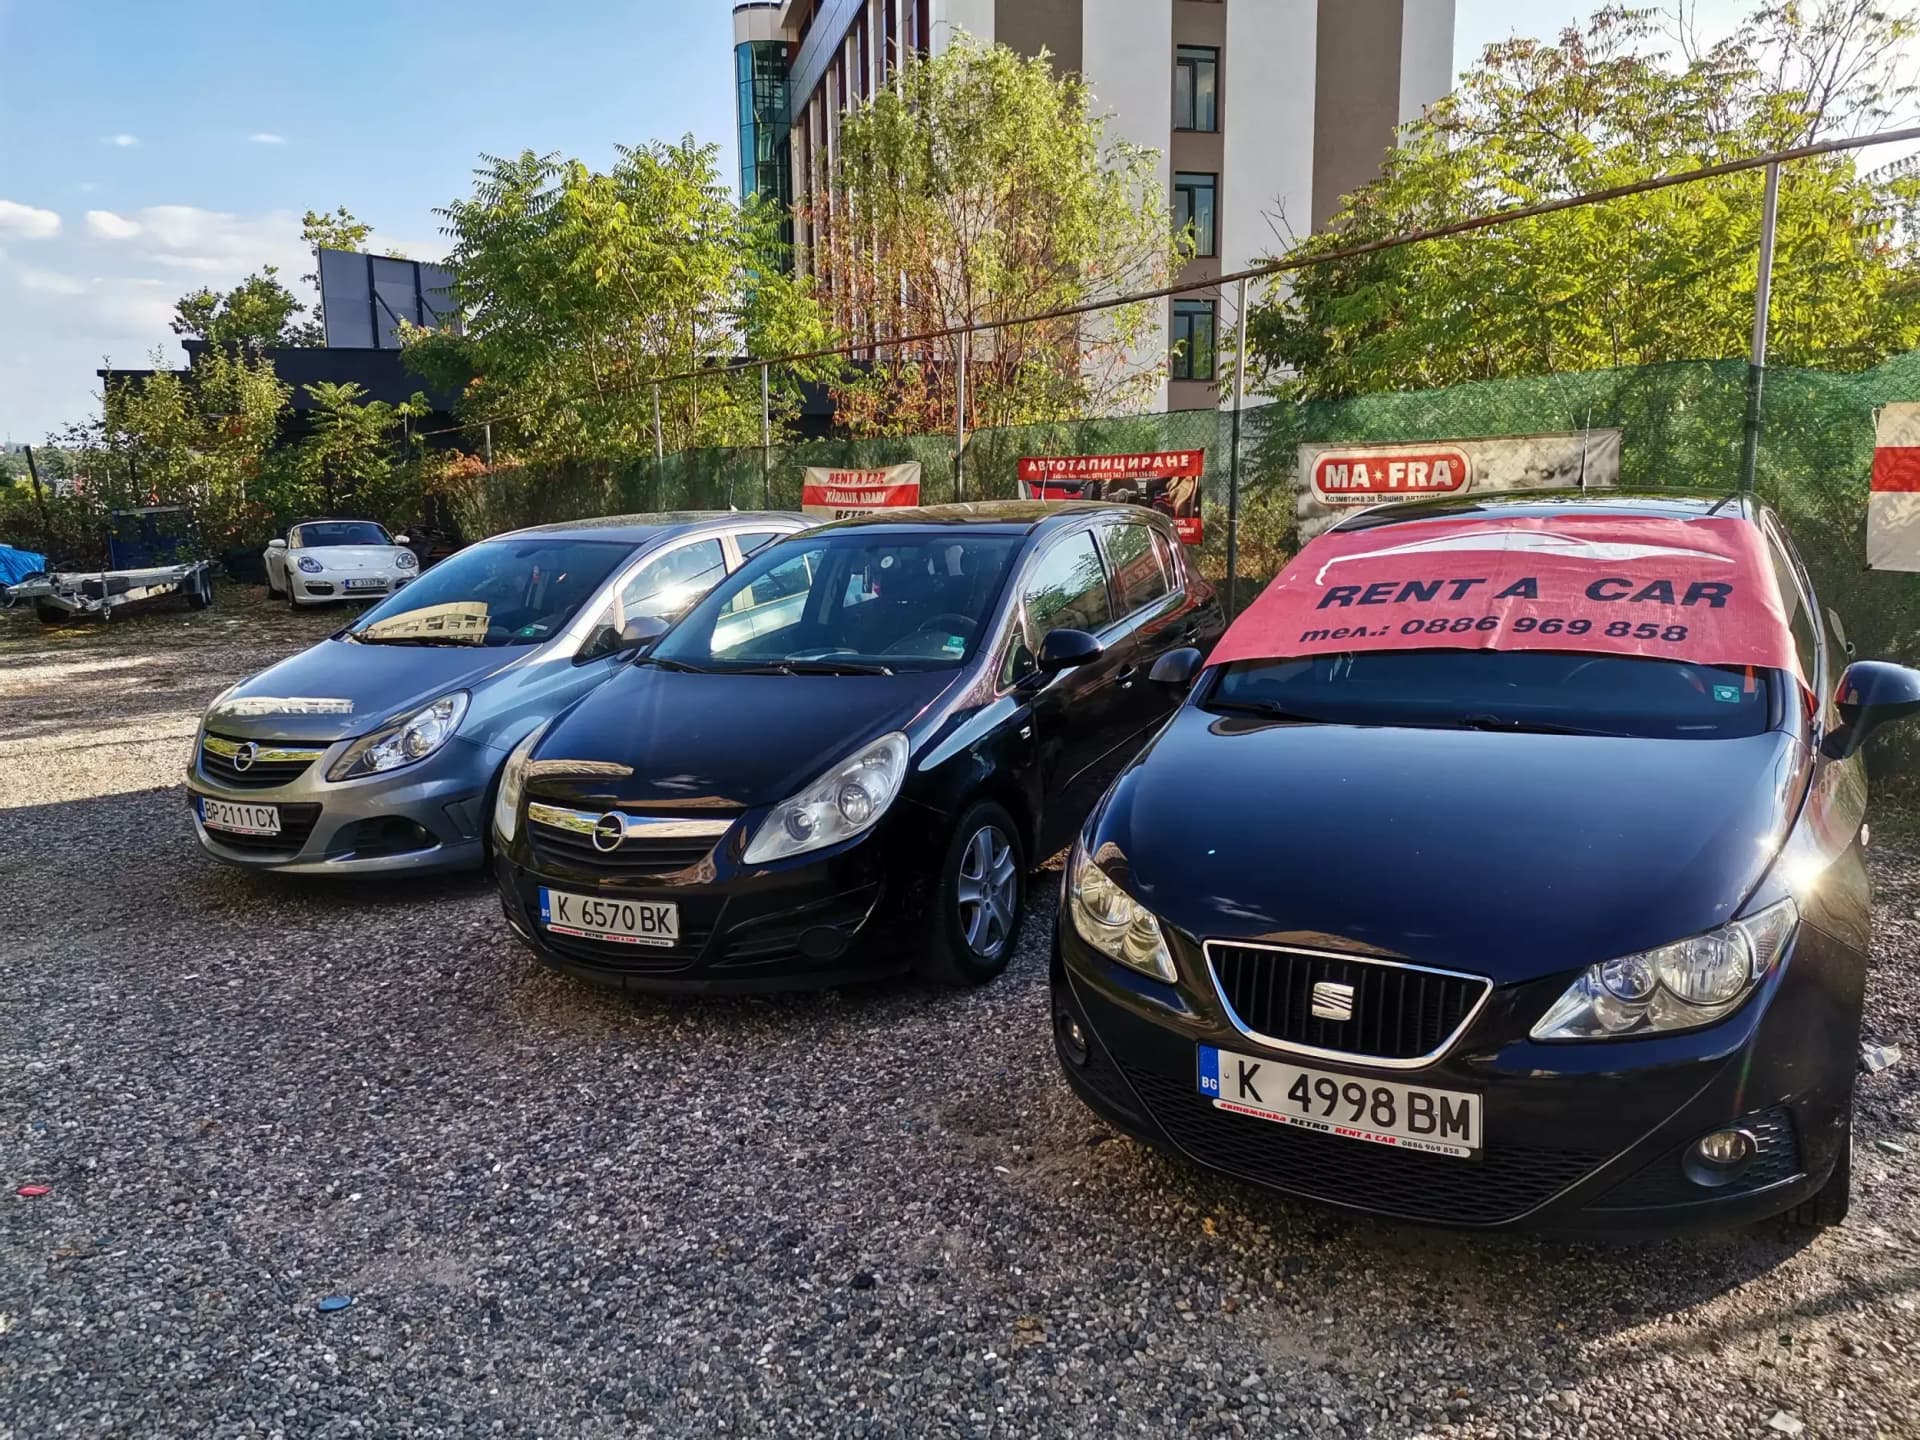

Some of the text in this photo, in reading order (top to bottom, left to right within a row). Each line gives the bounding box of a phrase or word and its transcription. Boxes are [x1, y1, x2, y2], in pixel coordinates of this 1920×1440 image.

[1028, 454, 1190, 472] АВТОТАПИЦИРАНЕ
[1325, 460, 1453, 489] MA FRA
[827, 472, 854, 484] RENT
[855, 472, 863, 483] A
[1325, 494, 1365, 503] Козметика
[1377, 493, 1403, 503] Вашия
[1316, 577, 1734, 610] RENT A CAR
[1400, 615, 1501, 635] 0886
[1512, 617, 1593, 636] 969
[1604, 620, 1689, 642] 858
[558, 895, 571, 922] K
[1201, 1076, 1218, 1090] BG
[1238, 1060, 1263, 1102] K
[1290, 1117, 1329, 1131] RETRO
[1335, 1127, 1362, 1138] RENT
[1375, 1134, 1396, 1145] CAR
[1425, 1143, 1441, 1152] 969
[1443, 1147, 1460, 1155] 858
